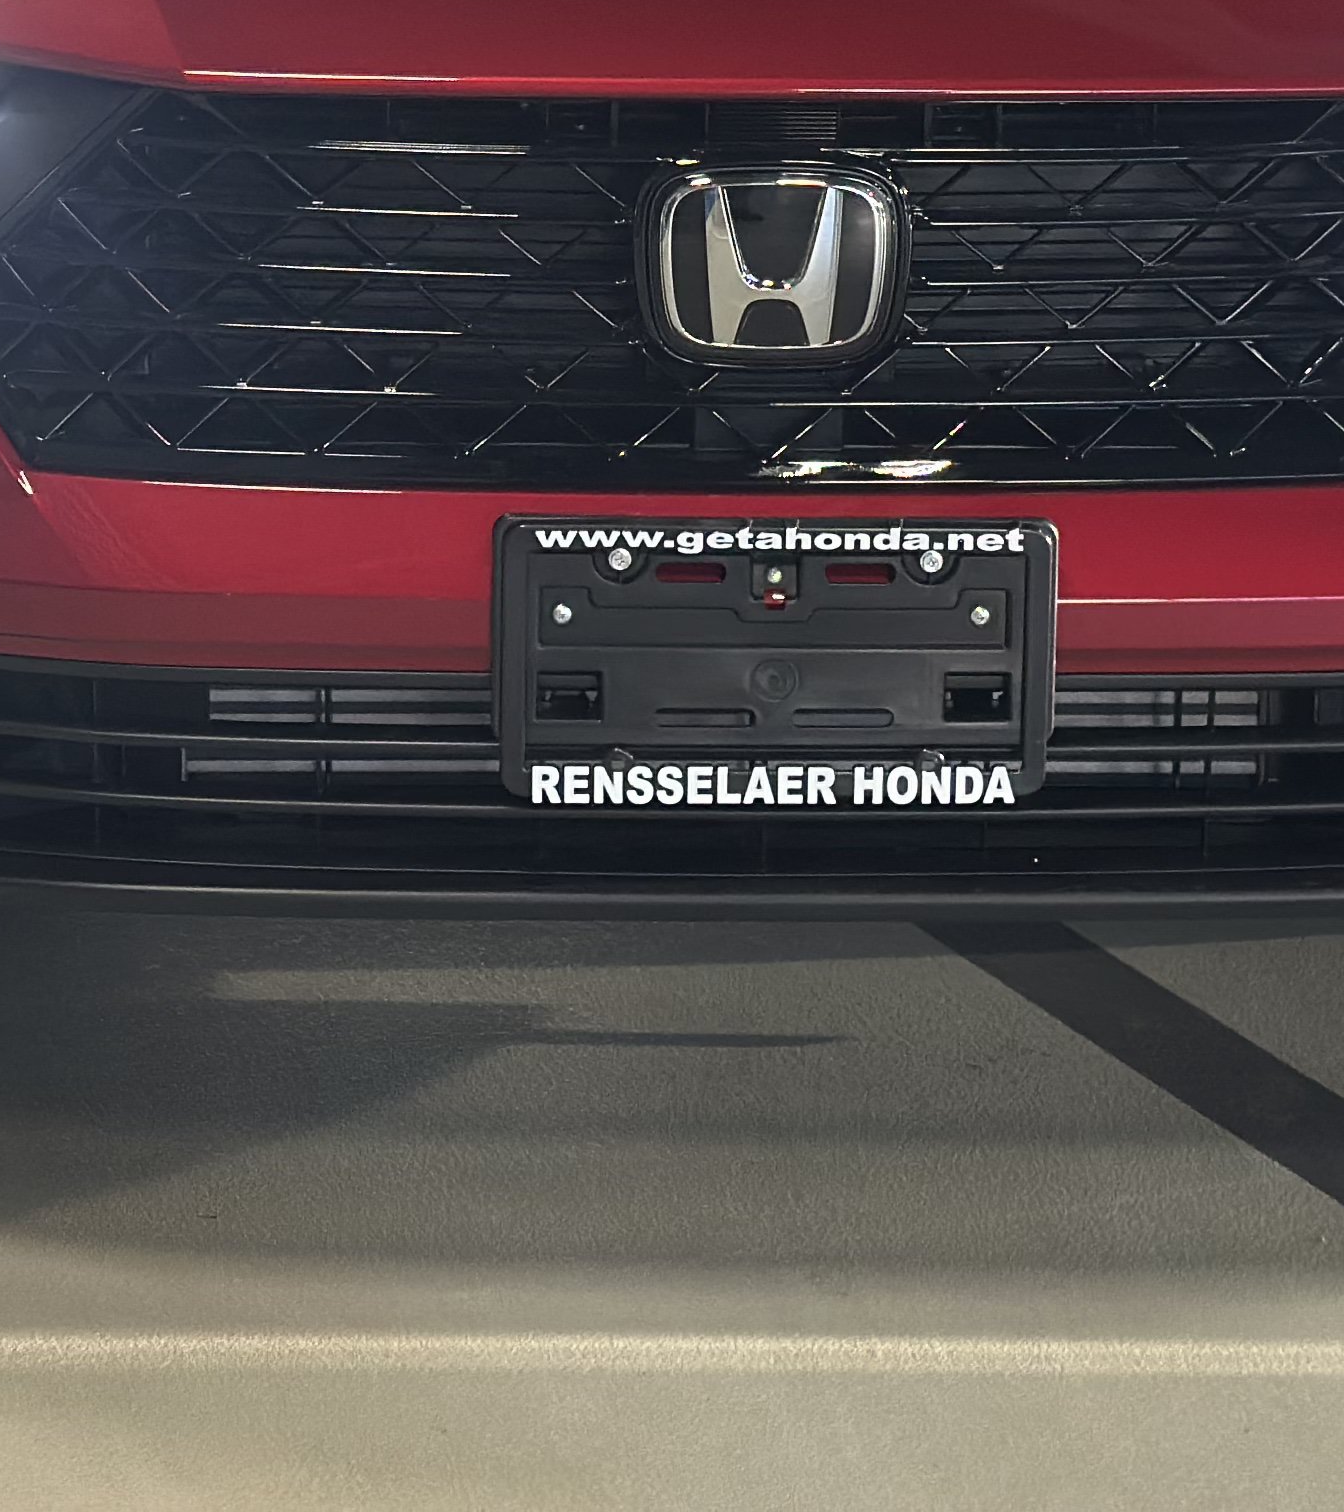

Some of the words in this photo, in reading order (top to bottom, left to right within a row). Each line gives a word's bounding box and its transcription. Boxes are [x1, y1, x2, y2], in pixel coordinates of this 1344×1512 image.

[535, 526, 1025, 554] www.getahonda.net
[531, 765, 837, 805] RENSSELAER
[853, 765, 1015, 805] HONDA
